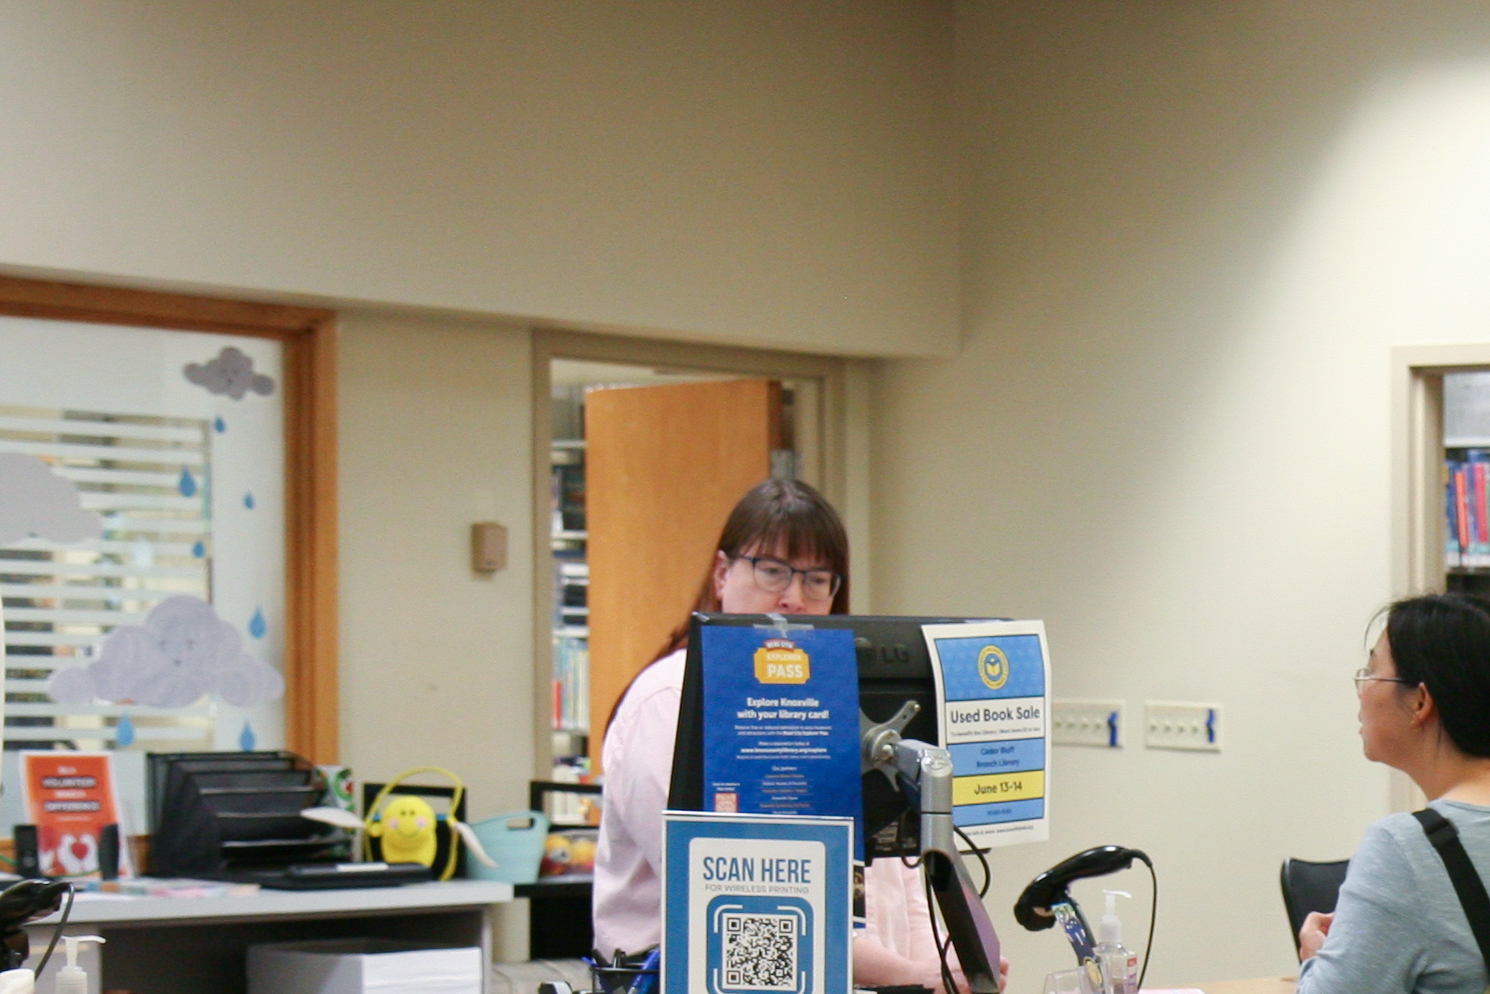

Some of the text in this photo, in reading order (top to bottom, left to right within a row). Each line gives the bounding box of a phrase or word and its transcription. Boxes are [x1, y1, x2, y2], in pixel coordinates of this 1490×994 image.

[881, 644, 910, 663] LG
[767, 664, 804, 679] PASS
[747, 697, 819, 708] Explore Knoxville
[737, 709, 829, 721] with your library card!
[950, 705, 1041, 724] Used Book Sale
[974, 781, 1023, 795] June 13-14
[702, 856, 811, 883] SCAN HERE
[705, 884, 809, 894] FOR WIRELESS PRINTING
